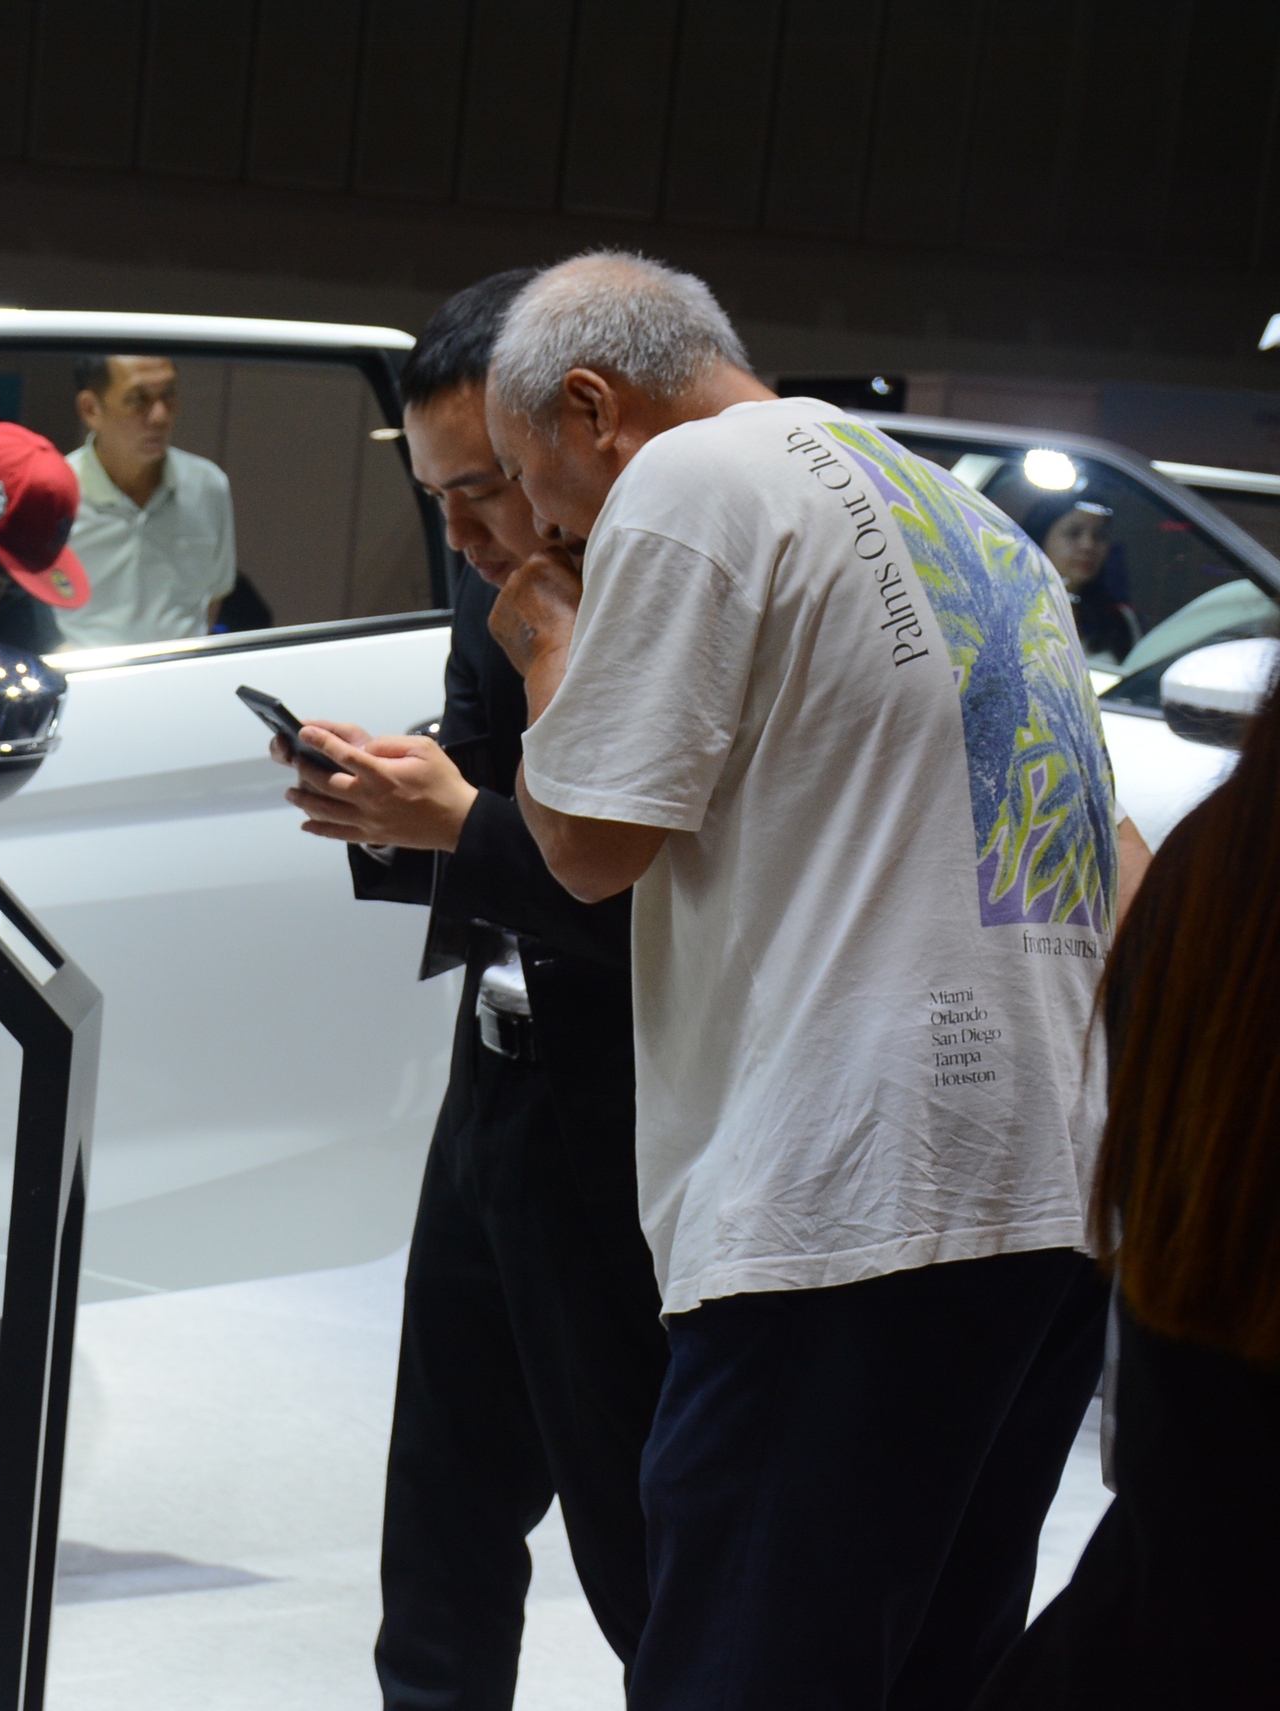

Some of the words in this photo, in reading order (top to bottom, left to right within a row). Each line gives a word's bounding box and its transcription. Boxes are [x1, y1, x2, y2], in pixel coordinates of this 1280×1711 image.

[841, 490, 888, 561] Out
[873, 561, 930, 668] Palms
[1053, 936, 1062, 956] a
[929, 986, 974, 1006] Miami
[930, 1006, 988, 1026] Orlando
[931, 1031, 958, 1047] San
[961, 1027, 1002, 1045] Diego
[932, 1050, 982, 1068] Tampa
[934, 1069, 996, 1087] Houston
